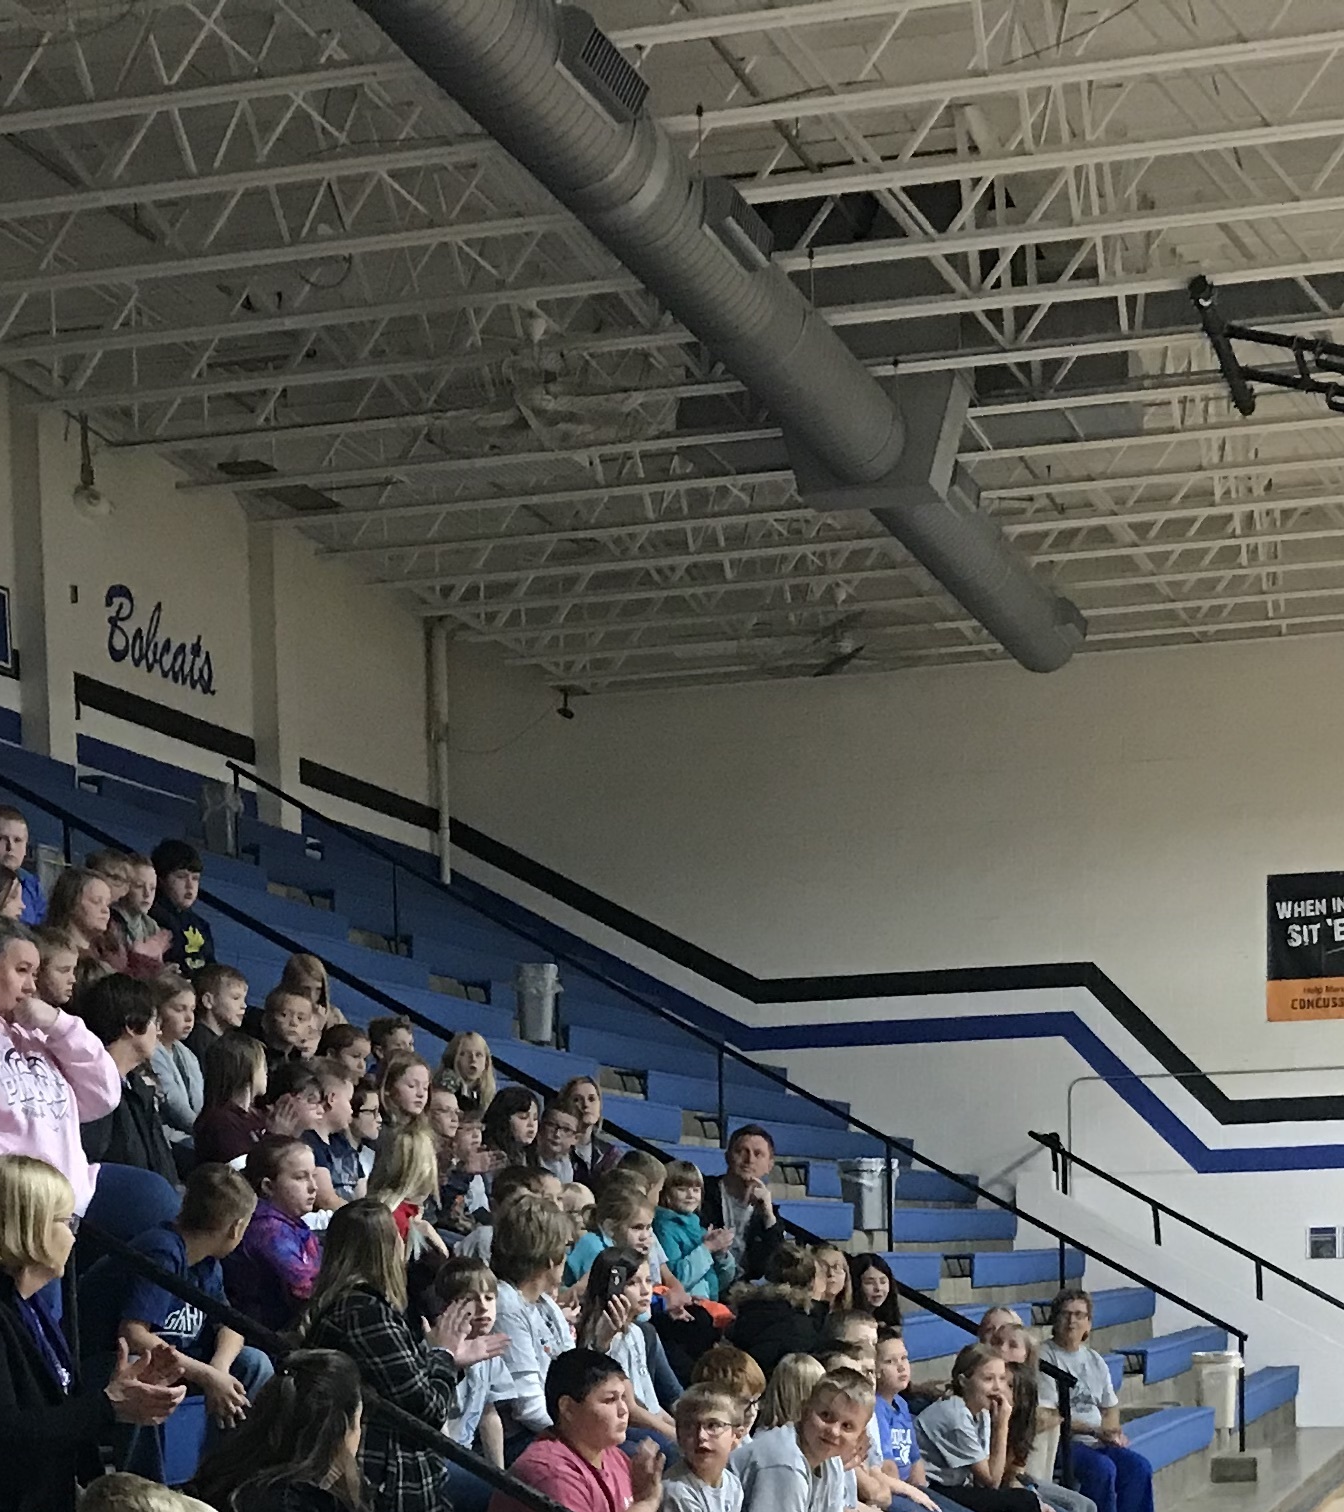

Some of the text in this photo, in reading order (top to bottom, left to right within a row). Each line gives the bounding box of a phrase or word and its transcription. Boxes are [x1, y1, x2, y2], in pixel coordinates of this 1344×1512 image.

[105, 584, 216, 696] Bobcats
[1276, 898, 1327, 920] WHEN
[1287, 922, 1321, 948] SIT
